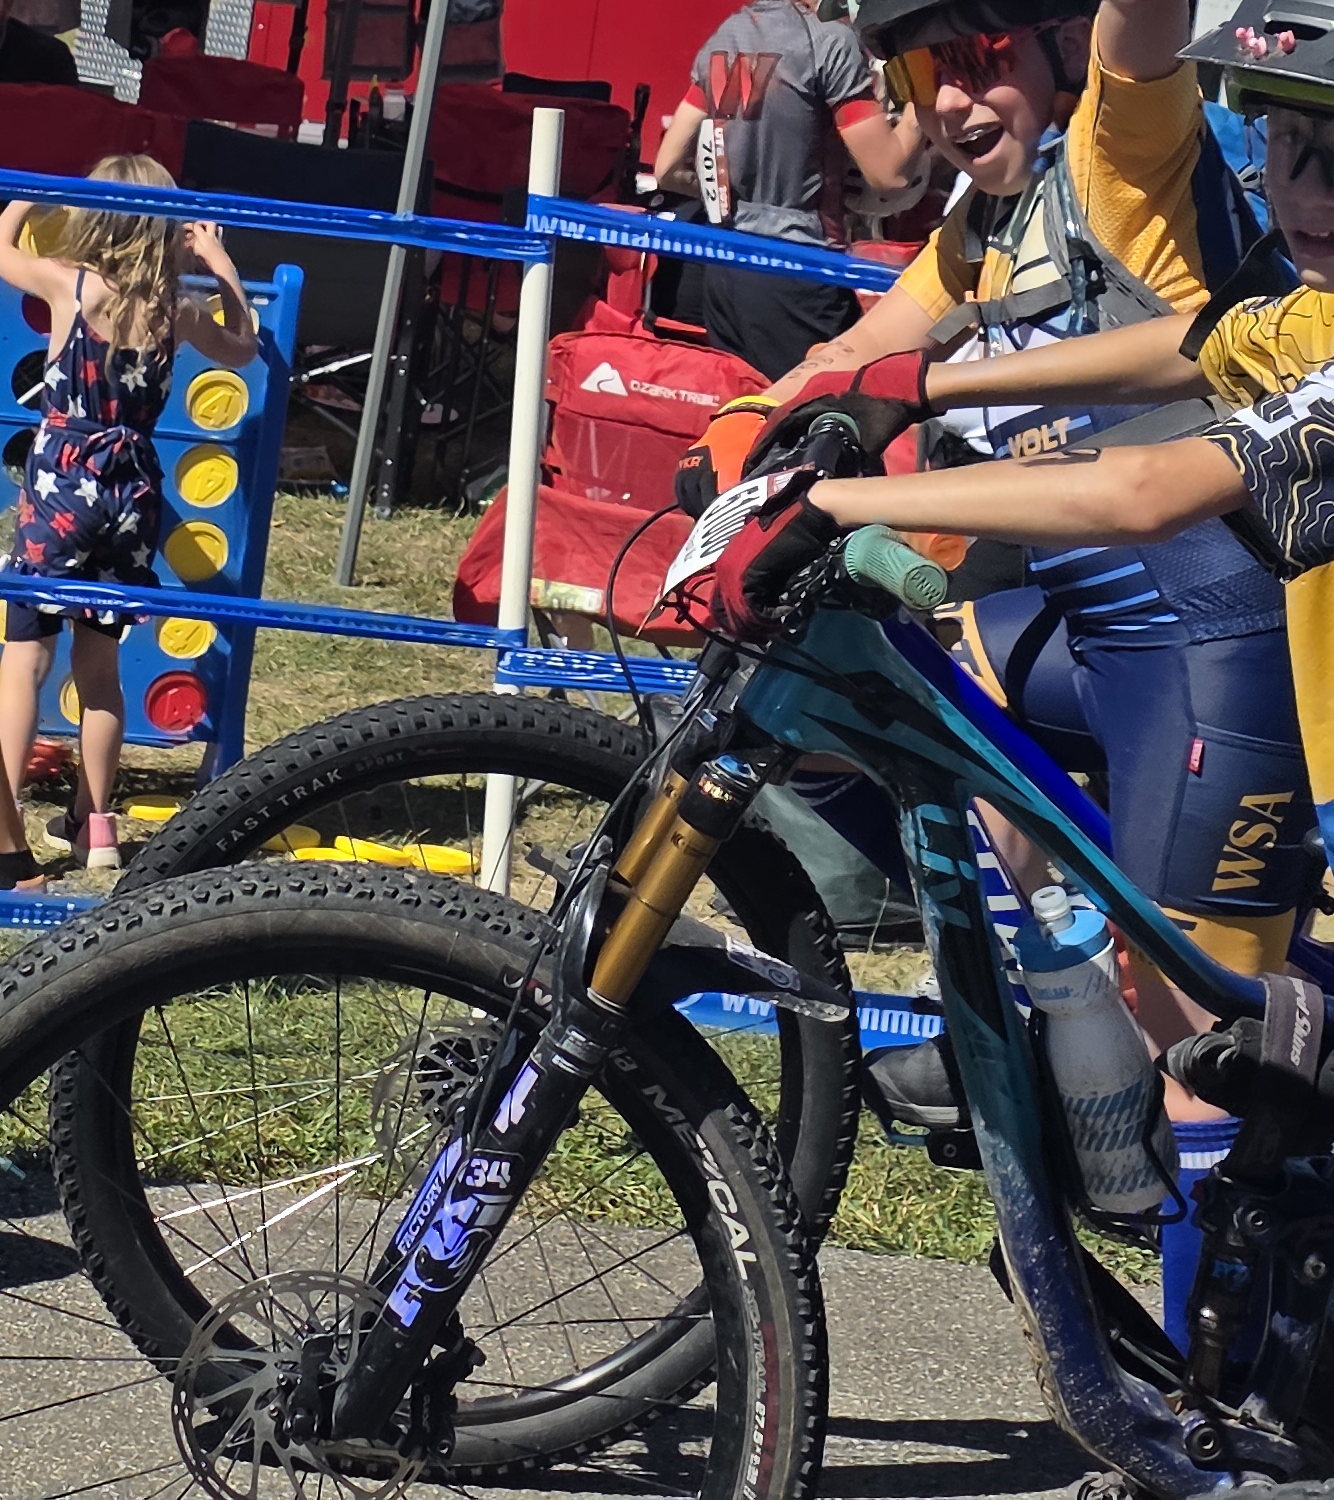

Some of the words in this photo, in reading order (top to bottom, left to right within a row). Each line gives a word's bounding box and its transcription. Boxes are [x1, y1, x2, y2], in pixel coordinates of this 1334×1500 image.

[701, 140, 716, 202] 7012
[1007, 415, 1071, 460] VOLT
[216, 805, 272, 852] FAST
[276, 767, 344, 808] TRAK
[1212, 791, 1295, 892] WSA
[465, 1158, 513, 1189] 34
[397, 1168, 446, 1256] FACTORY
